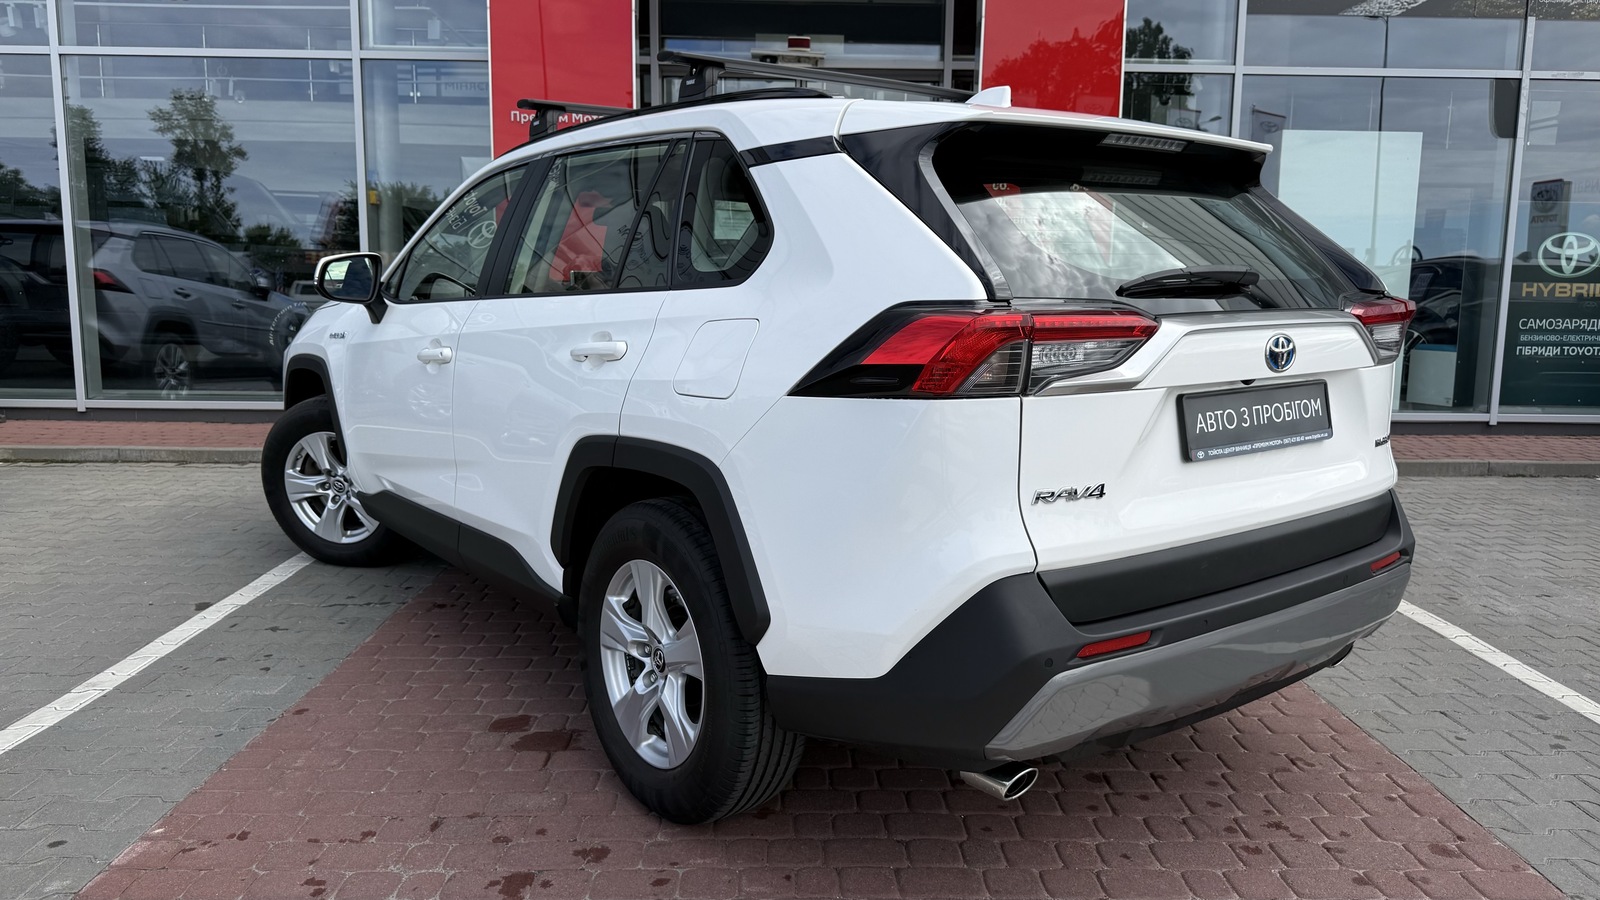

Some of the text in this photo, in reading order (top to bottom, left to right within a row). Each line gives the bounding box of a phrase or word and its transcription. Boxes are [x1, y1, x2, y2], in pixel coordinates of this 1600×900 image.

[511, 111, 568, 124] Прем
[1518, 318, 1600, 332] САМОЗАРЯД
[1516, 346, 1561, 357] ГІБРИДИ
[1196, 409, 1237, 434] АВТО
[1252, 397, 1323, 426] ПРОБІГОМ
[1031, 482, 1106, 506] RAV4
